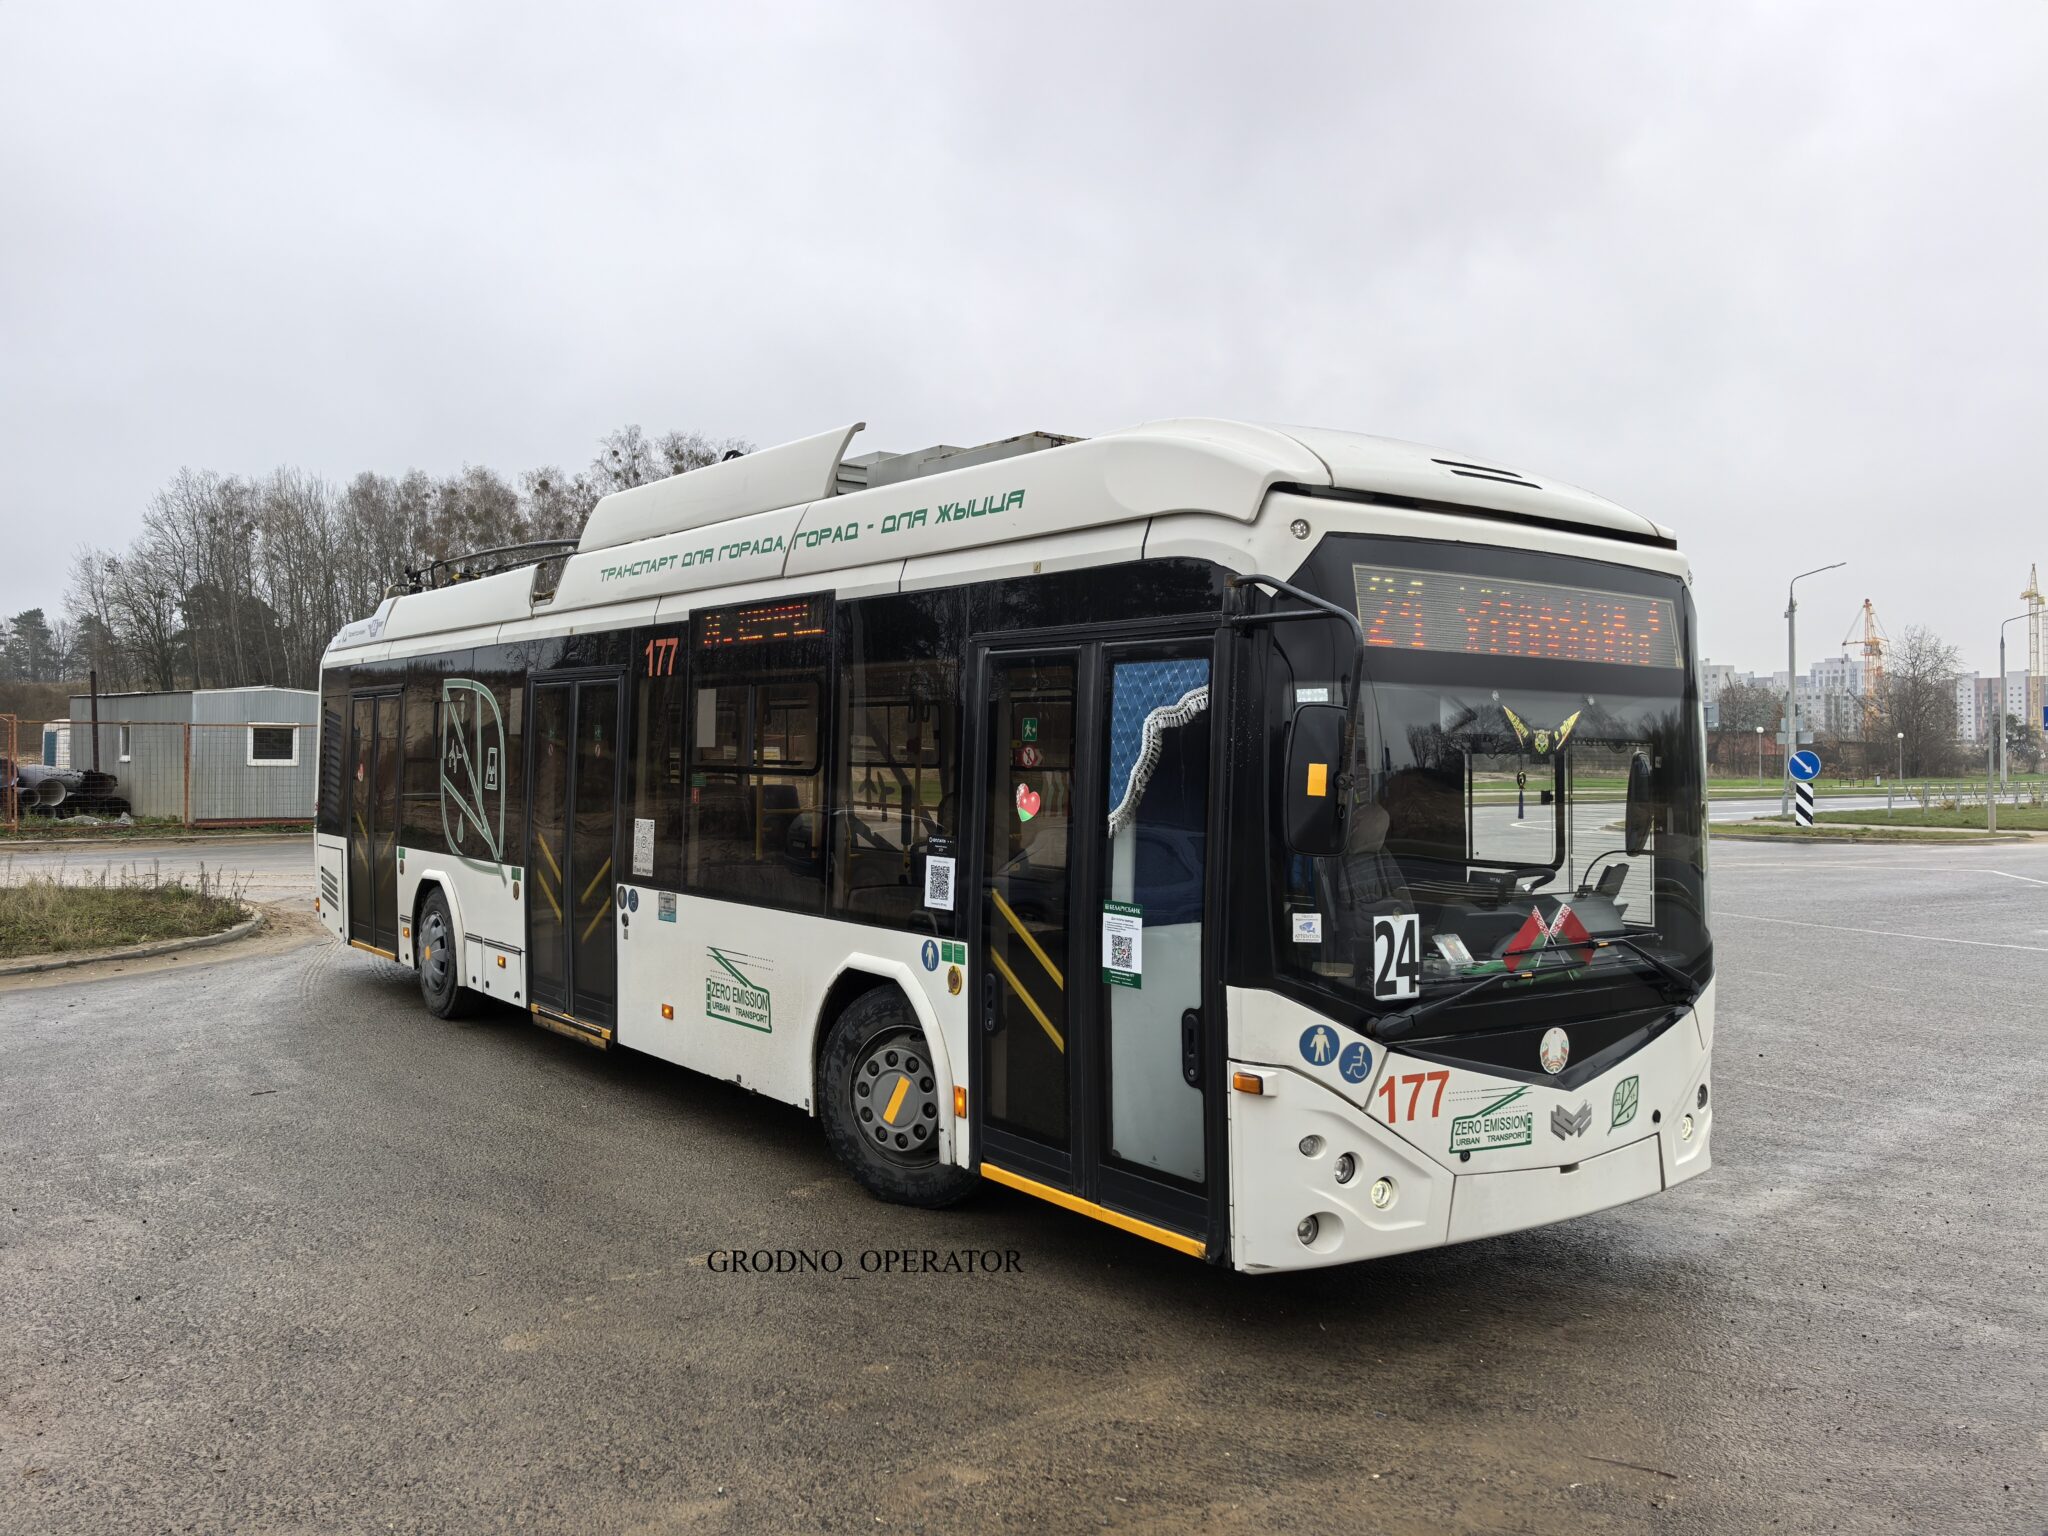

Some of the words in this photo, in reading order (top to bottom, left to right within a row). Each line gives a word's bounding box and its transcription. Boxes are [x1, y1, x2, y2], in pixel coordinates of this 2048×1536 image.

[600, 555, 678, 582] ТРАНСПАРТ
[681, 548, 714, 568] ДЛЯ
[718, 535, 787, 561] ГОРАДА,
[793, 522, 858, 550] ГОРАД
[881, 508, 928, 534] ДЛЯ
[935, 489, 1025, 524] ЖЫЦЦЯ
[645, 637, 679, 677] 177
[1375, 919, 1420, 997] 24
[711, 981, 731, 1002] ZERO
[732, 986, 768, 1012] EMISSION
[712, 1000, 731, 1014] URBAN
[735, 1006, 768, 1025] TRANSPORT
[1378, 1070, 1450, 1124] 177
[1455, 1120, 1482, 1136] ZERO
[1484, 1114, 1527, 1133] EMISSION
[1456, 1136, 1480, 1147] URBAN
[1487, 1131, 1525, 1143] TRANSPORT
